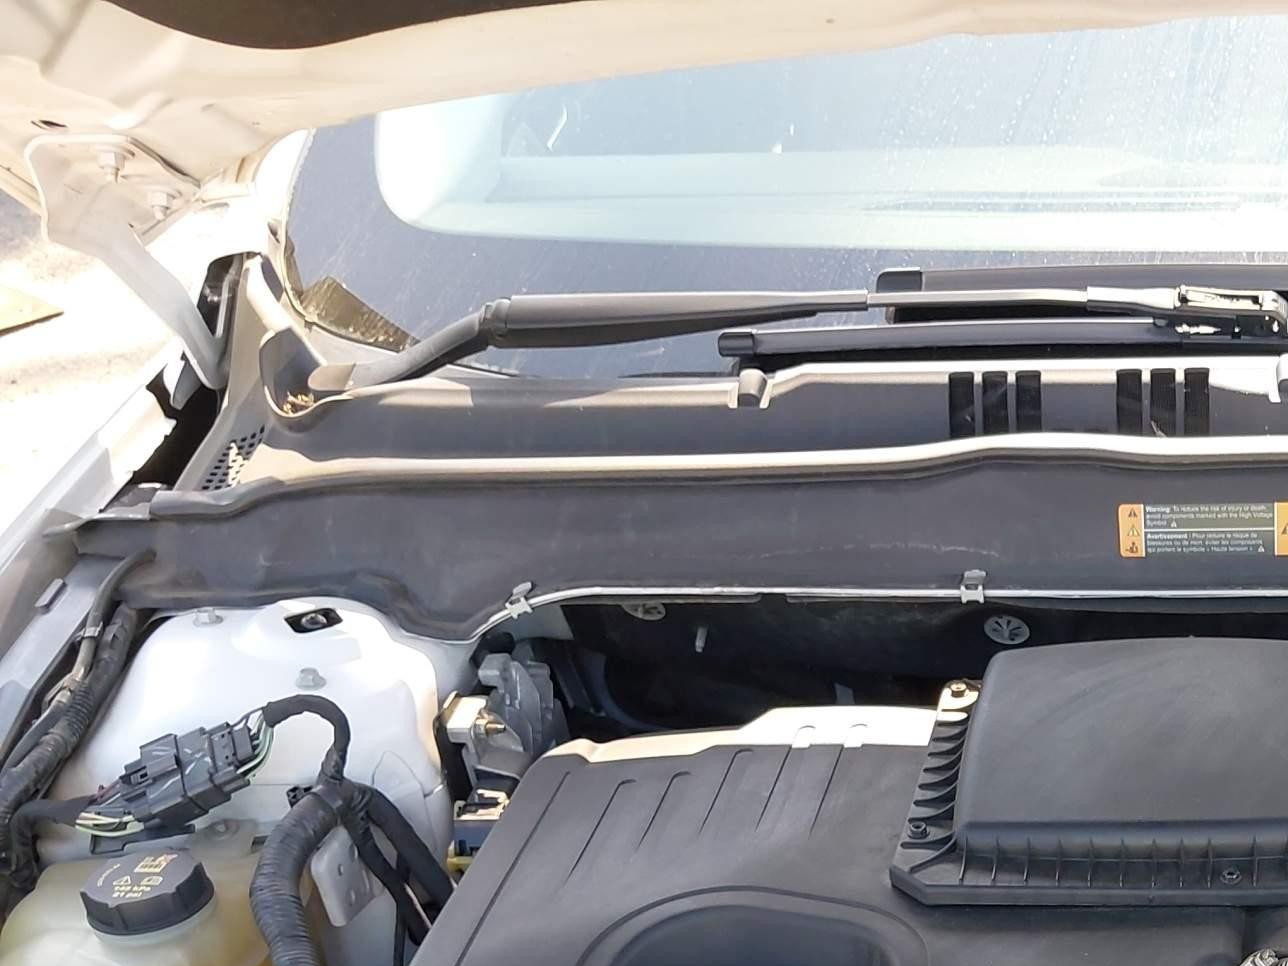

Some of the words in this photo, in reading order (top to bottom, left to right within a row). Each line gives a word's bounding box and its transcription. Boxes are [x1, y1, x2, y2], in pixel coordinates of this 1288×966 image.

[1210, 505, 1220, 513] risk
[1221, 505, 1227, 513] of
[1228, 505, 1243, 513] injury
[1243, 505, 1250, 513] or
